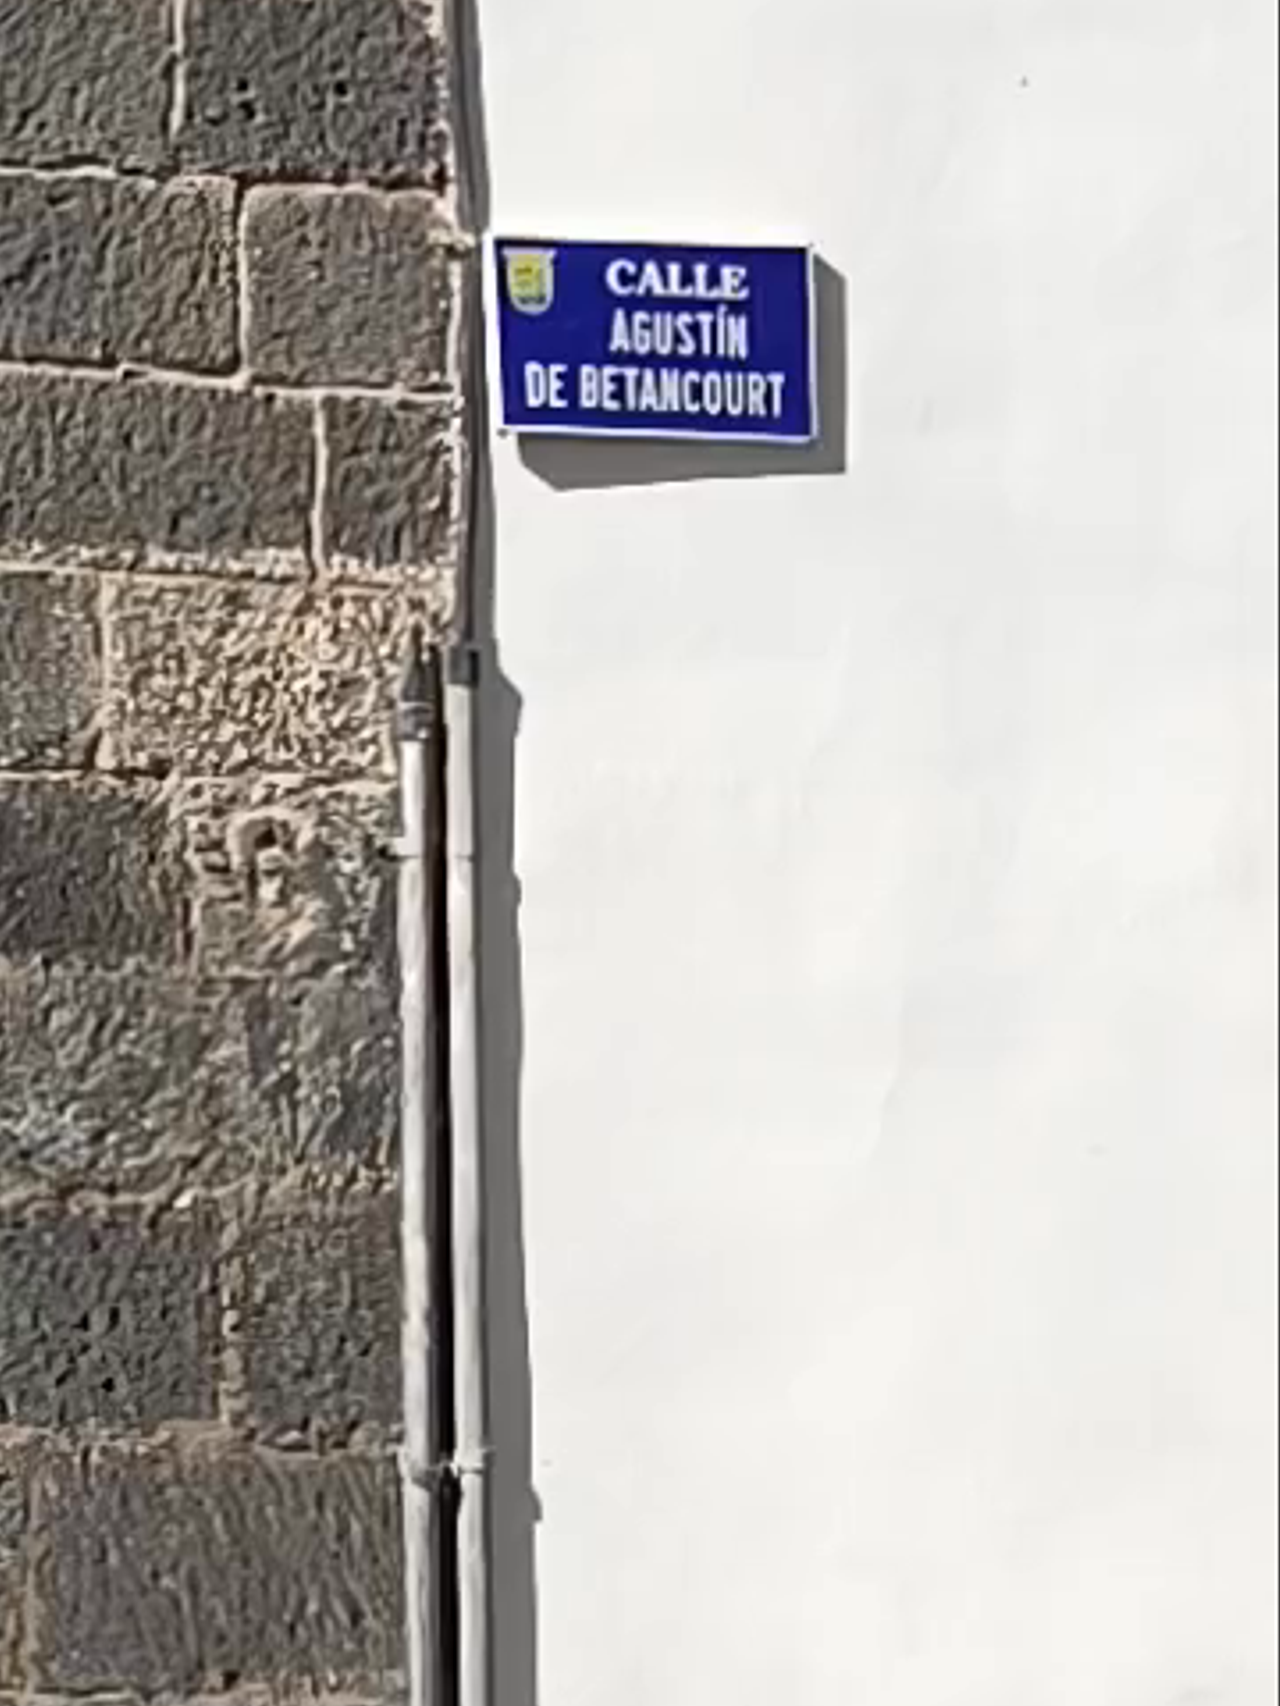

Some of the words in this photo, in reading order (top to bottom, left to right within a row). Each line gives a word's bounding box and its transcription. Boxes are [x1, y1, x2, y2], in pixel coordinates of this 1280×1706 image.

[606, 259, 749, 300] CALLE
[609, 304, 749, 360] AGUSTÍN
[524, 360, 568, 408] DE
[580, 363, 785, 418] BETANCOURT
